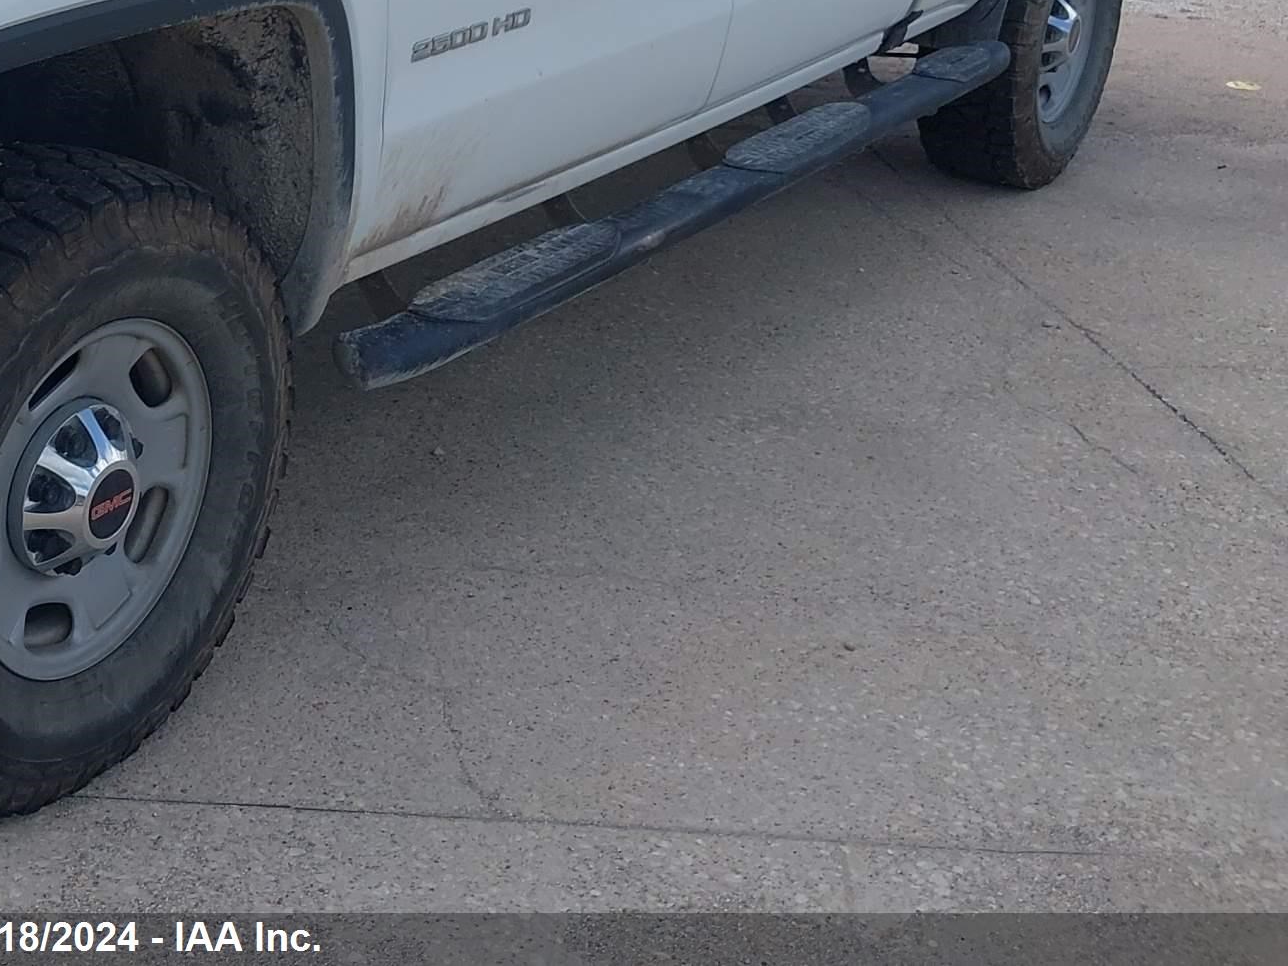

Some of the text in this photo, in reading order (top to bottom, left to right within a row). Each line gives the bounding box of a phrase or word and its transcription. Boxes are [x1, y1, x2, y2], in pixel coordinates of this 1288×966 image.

[410, 7, 532, 64] 2500 HD
[91, 488, 133, 521] GMC
